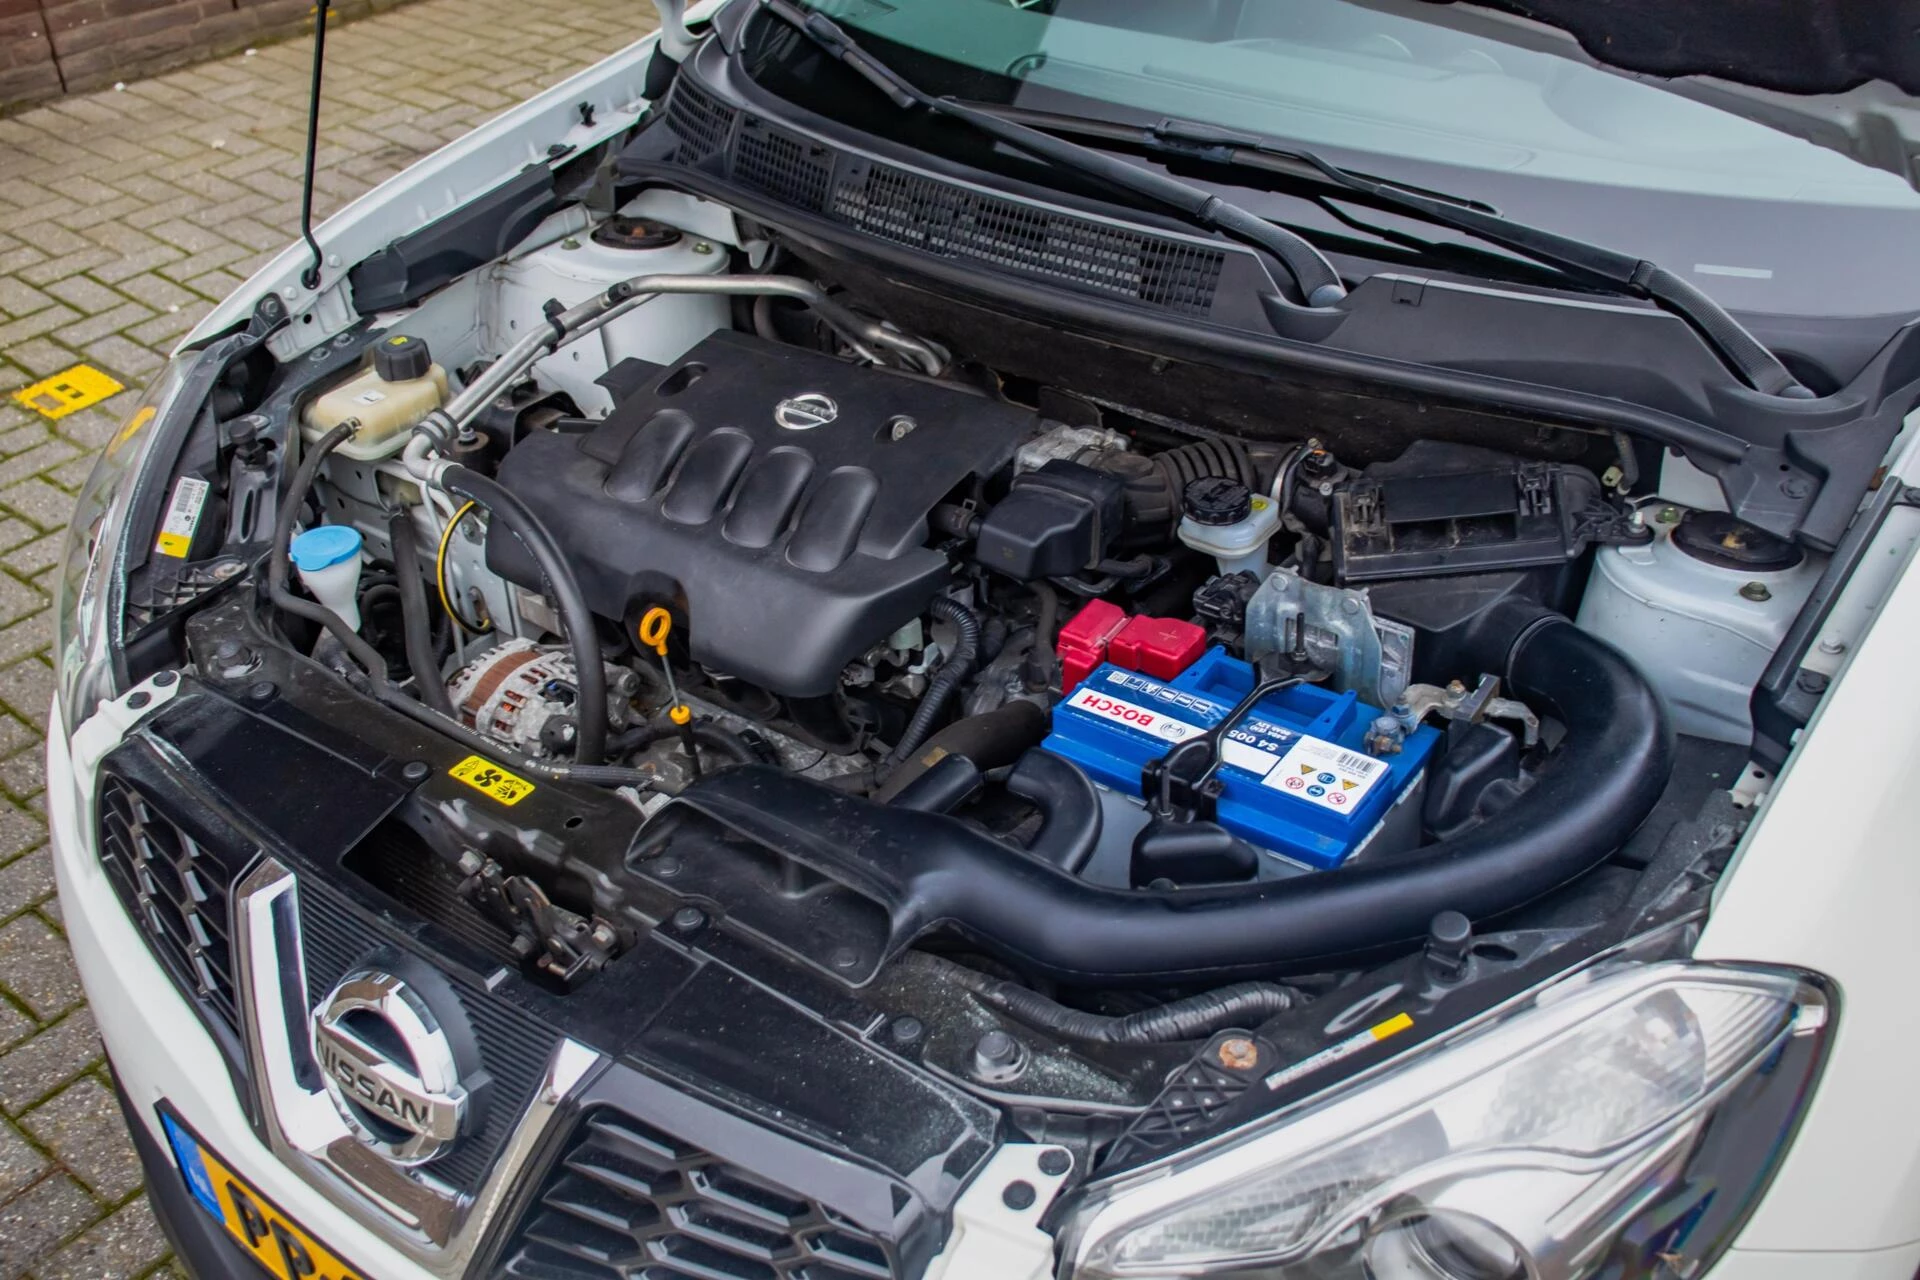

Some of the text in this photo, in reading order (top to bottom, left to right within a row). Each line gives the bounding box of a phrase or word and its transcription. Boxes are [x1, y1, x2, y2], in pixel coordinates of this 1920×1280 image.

[1082, 694, 1155, 726] BOSCH
[1227, 729, 1279, 752] S4 005
[317, 1037, 430, 1125] NISSAN
